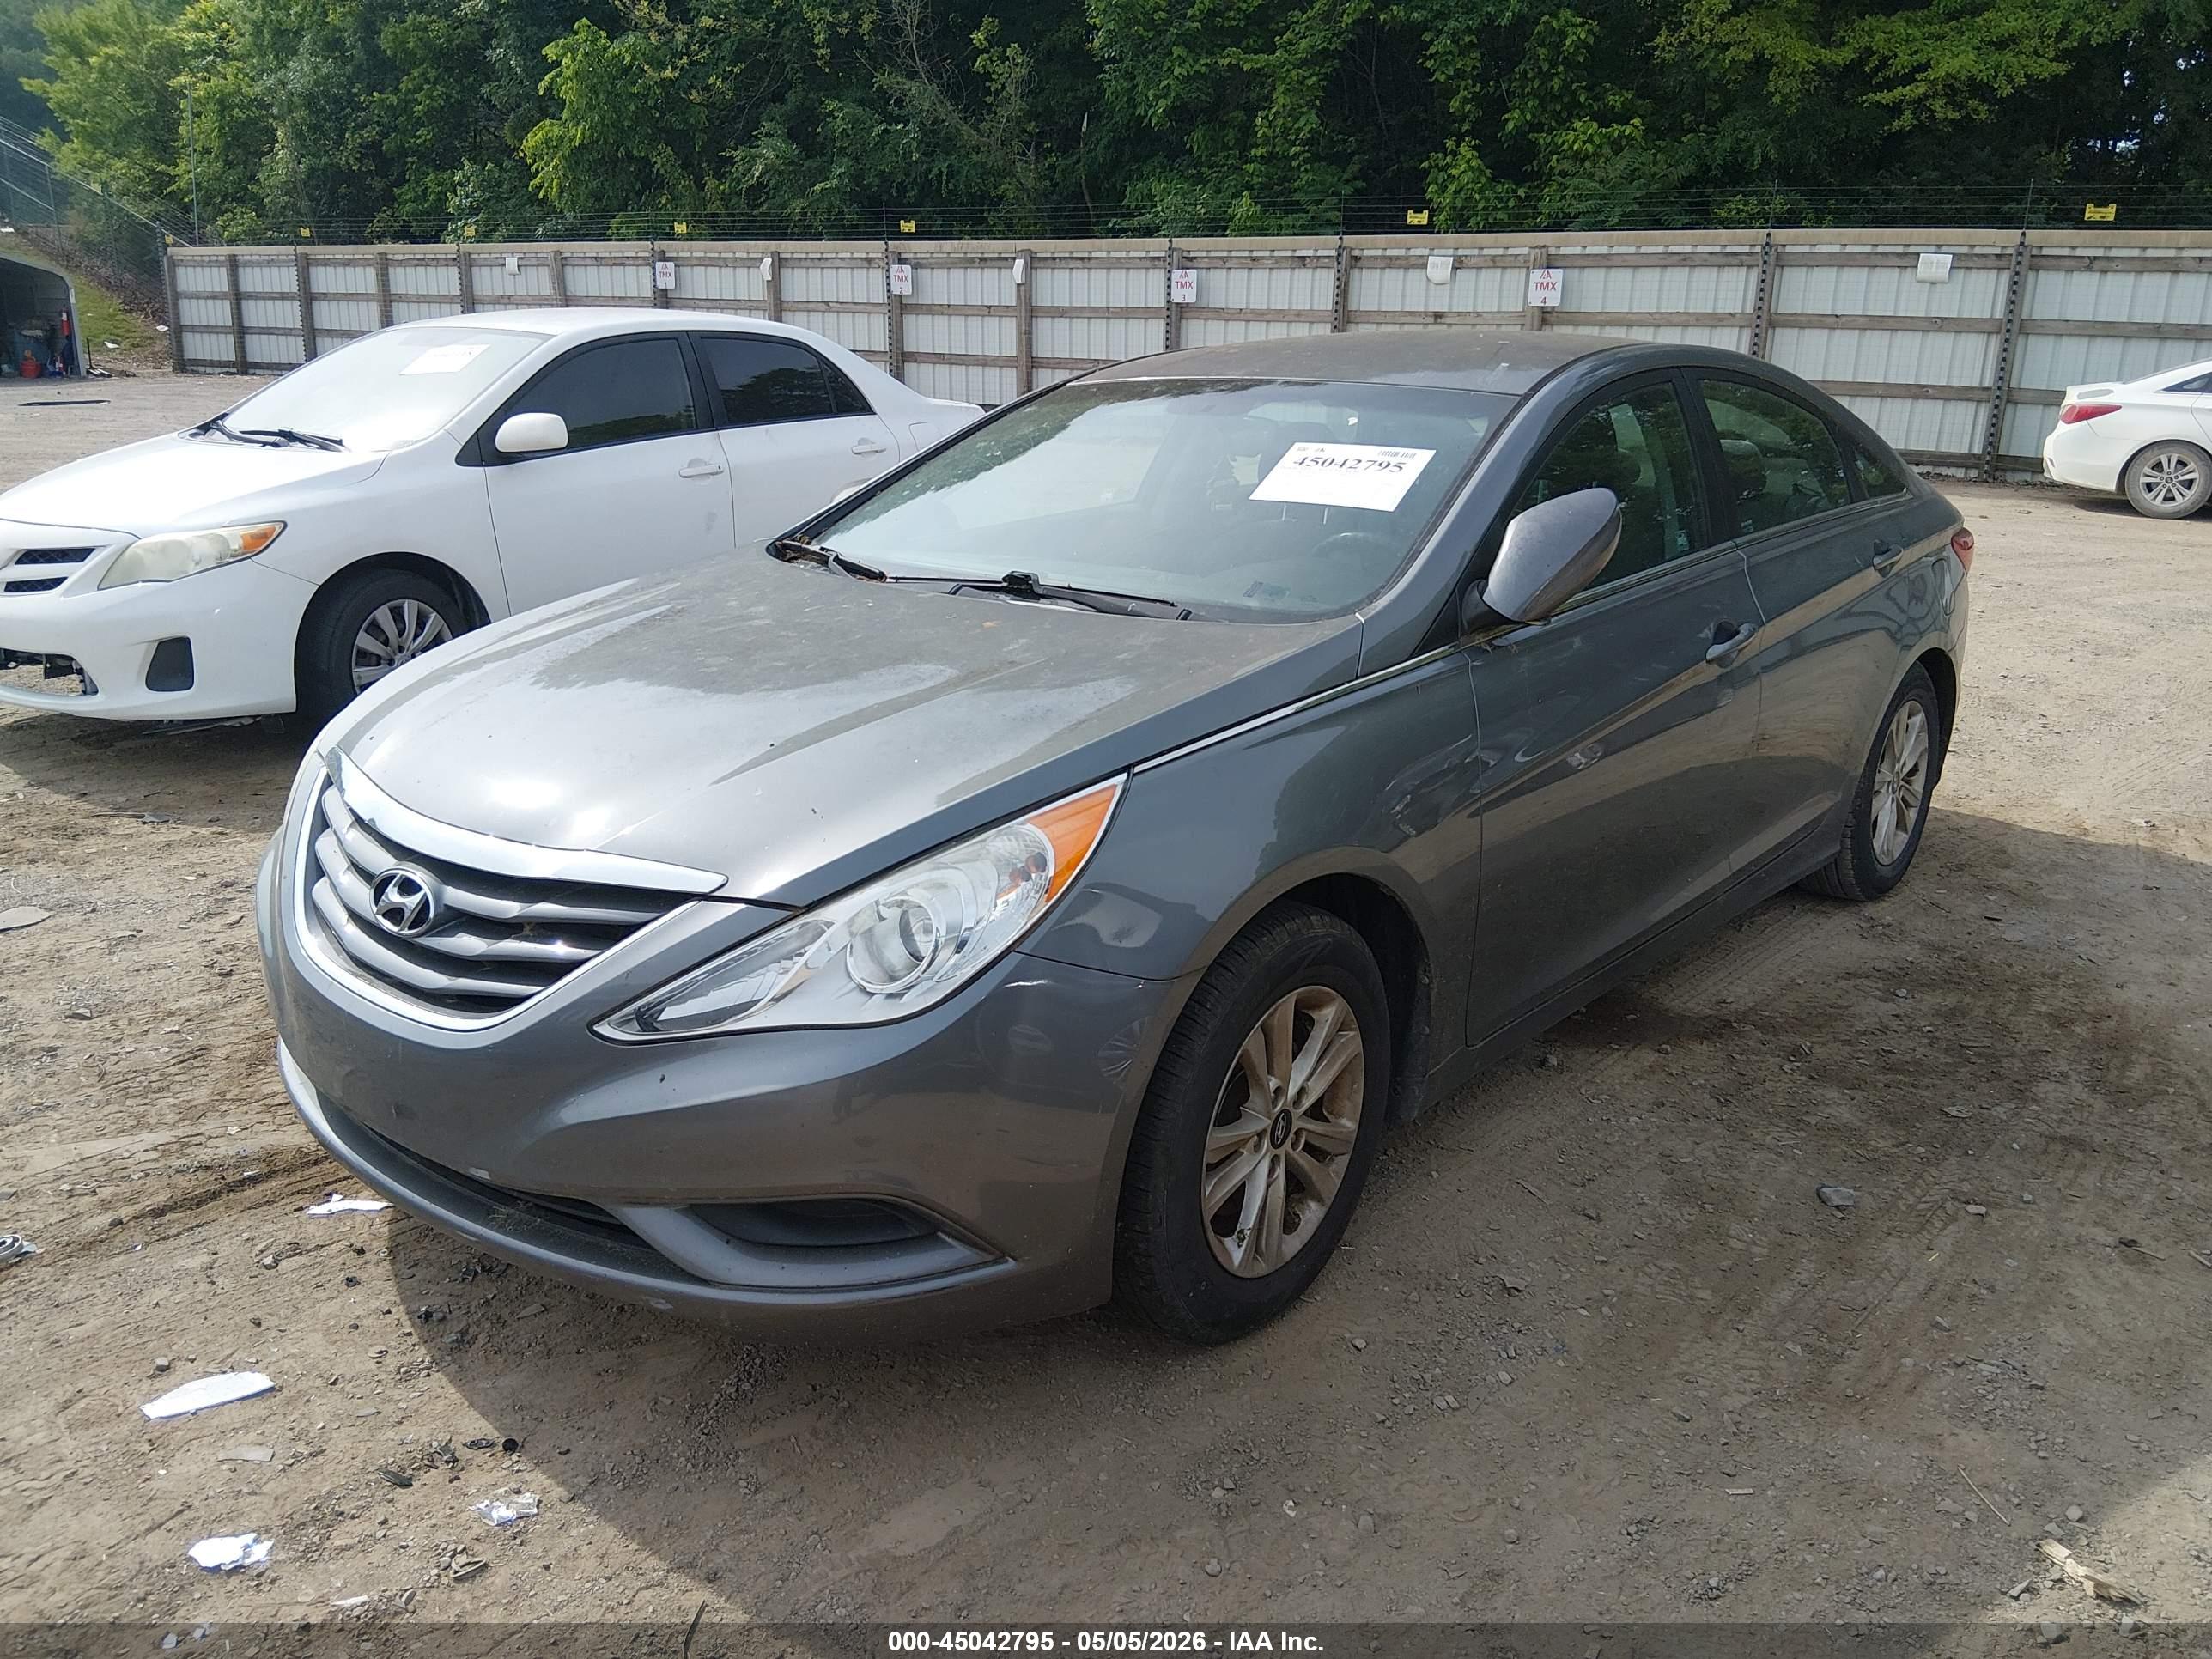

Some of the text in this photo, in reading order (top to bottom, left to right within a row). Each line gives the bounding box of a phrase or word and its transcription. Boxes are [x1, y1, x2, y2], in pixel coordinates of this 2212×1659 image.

[1176, 281, 1194, 289] TMX
[1534, 282, 1557, 291] TMX
[1540, 296, 1547, 305] 4
[1293, 456, 1408, 473] 45042795
